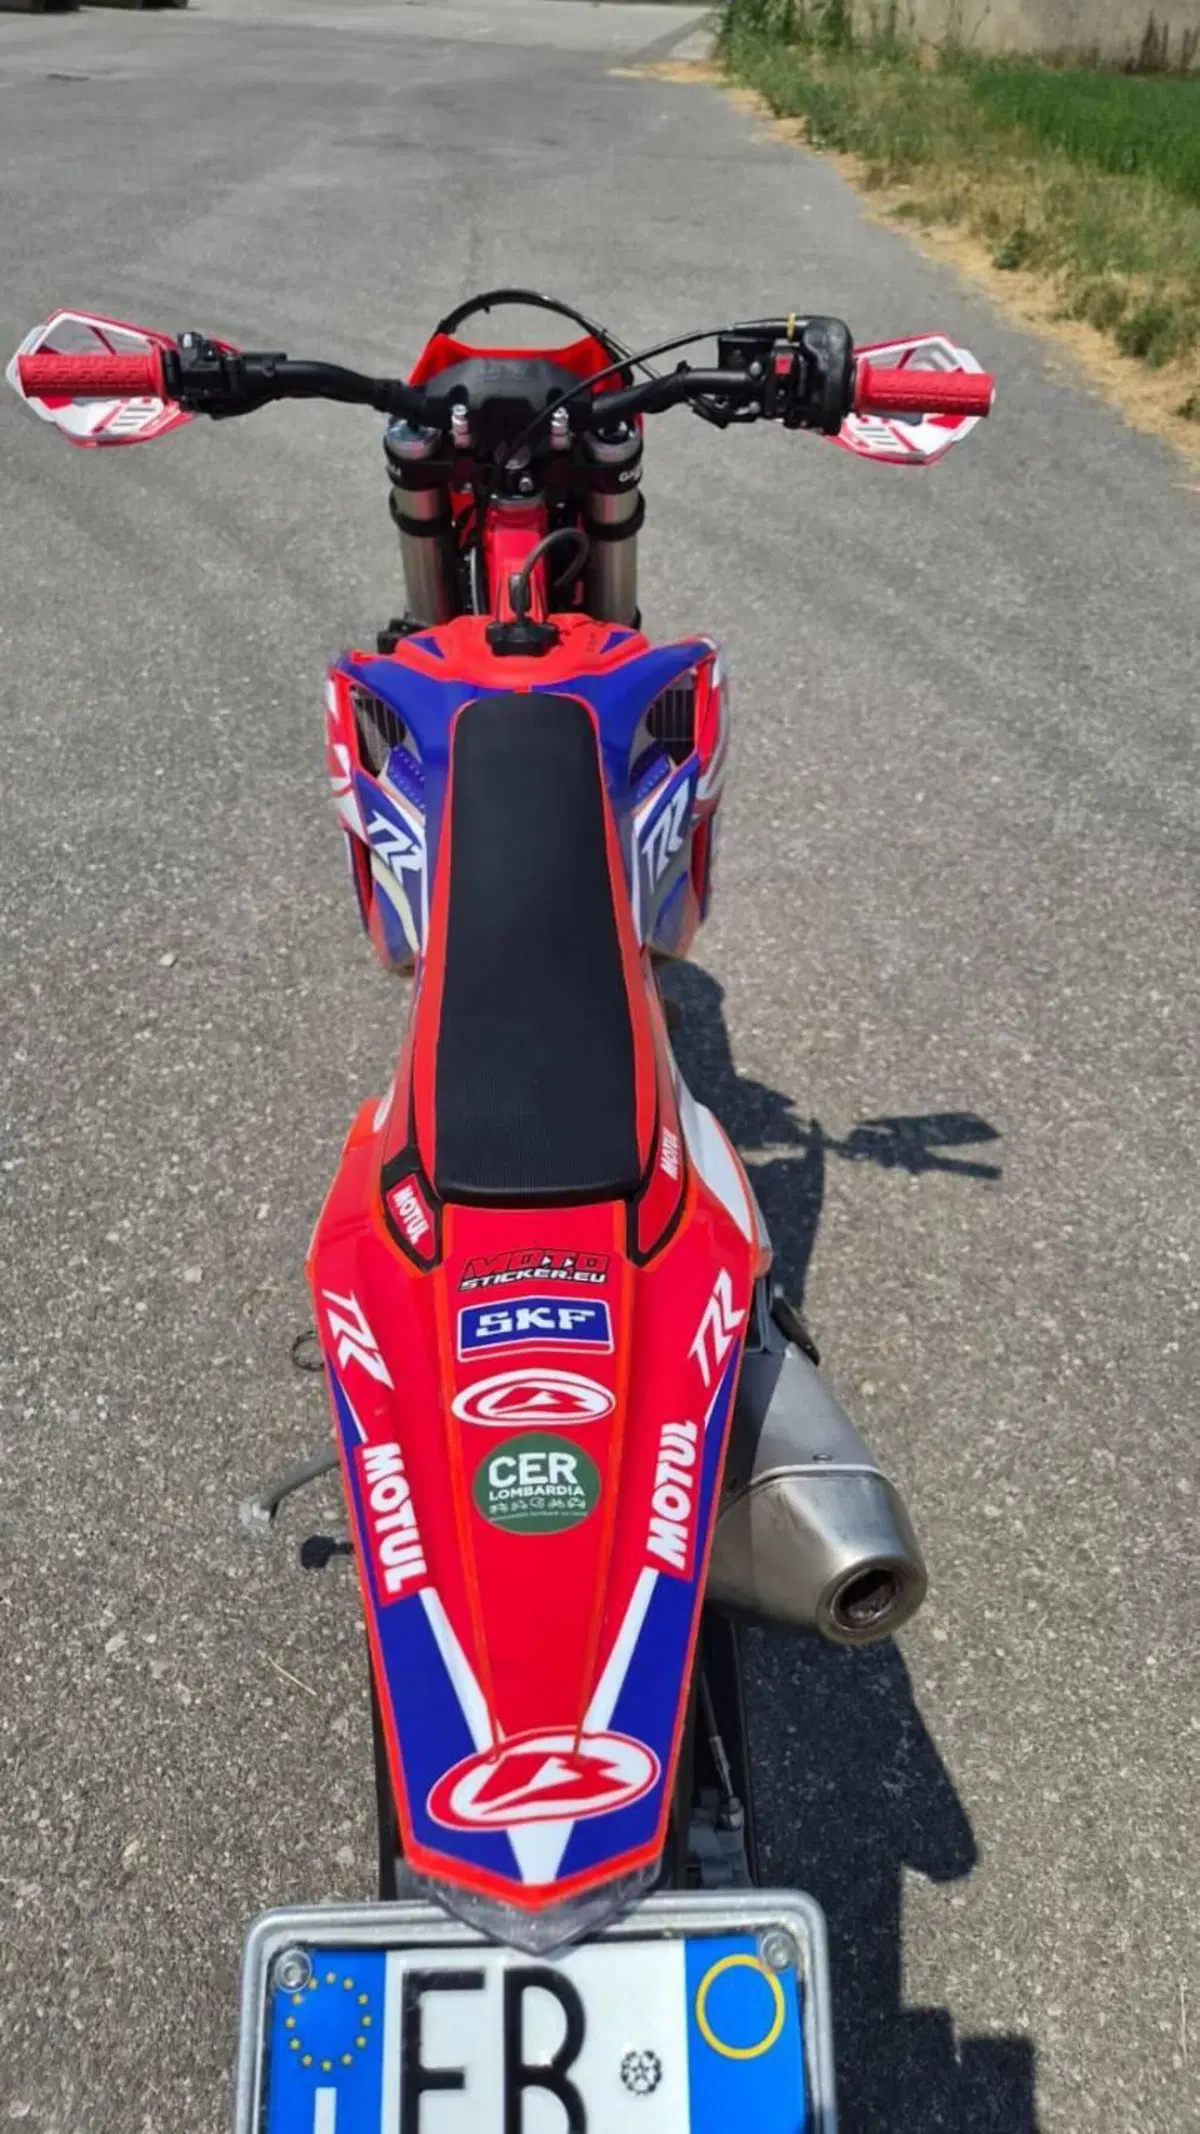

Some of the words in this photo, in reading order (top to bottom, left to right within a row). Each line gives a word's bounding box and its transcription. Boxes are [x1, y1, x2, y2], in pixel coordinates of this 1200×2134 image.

[393, 1185, 430, 1245] MOTUL
[459, 1267, 607, 1292] STICKER.EU
[463, 1249, 610, 1281] MOTO
[475, 1306, 596, 1338] SKF
[488, 1452, 578, 1488] CER
[488, 1485, 586, 1502] LOMBARDIA
[646, 1419, 698, 1571] MOTUL
[362, 1442, 427, 1594] MOTUL
